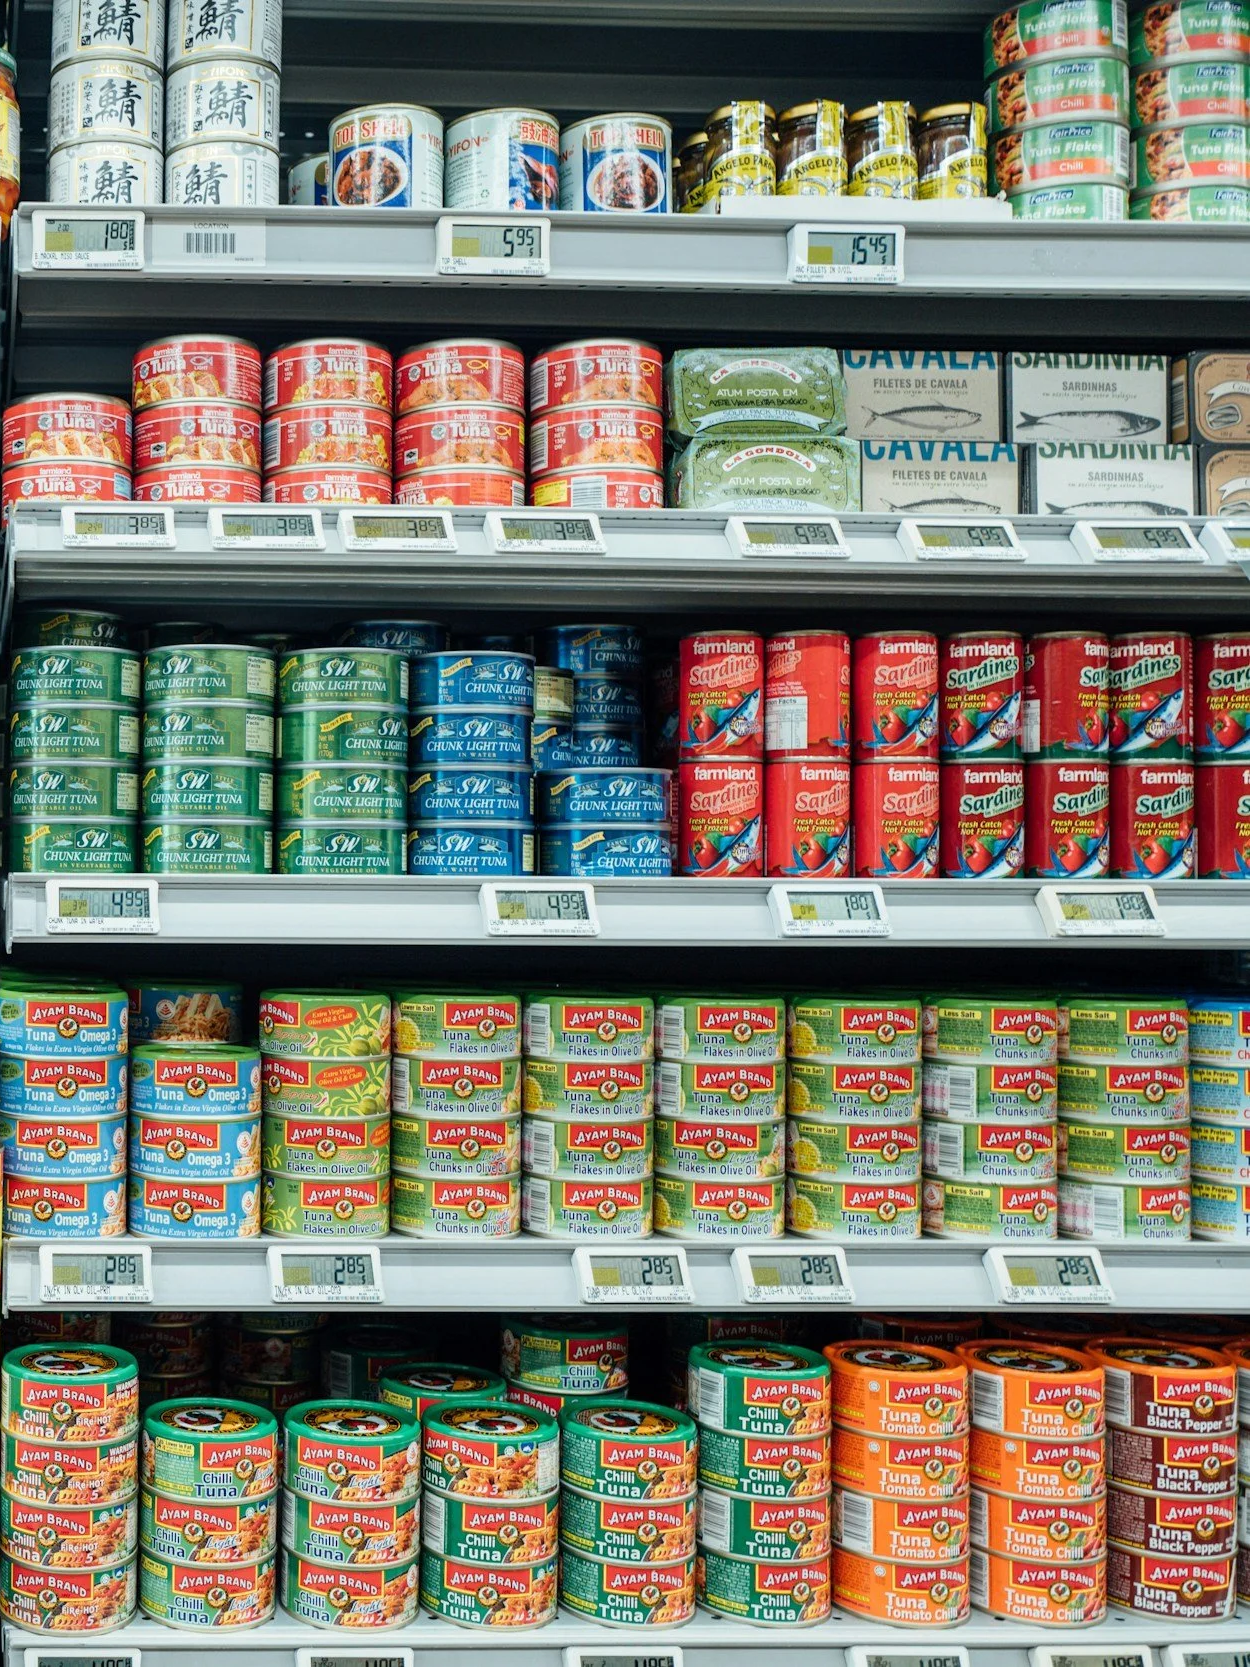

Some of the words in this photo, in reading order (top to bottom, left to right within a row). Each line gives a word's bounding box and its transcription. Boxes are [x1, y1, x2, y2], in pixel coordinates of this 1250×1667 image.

[1053, 63, 1094, 75] FairPrice
[1034, 81, 1063, 95] Tuna
[1068, 78, 1105, 89] Flakes
[95, 80, 142, 129] 鯖
[1061, 100, 1084, 109] Chilli
[336, 125, 357, 146] TOP
[449, 135, 481, 159] YIFON
[1030, 144, 1060, 157] Tuna
[1065, 140, 1102, 152] Flakes
[713, 156, 752, 180] ANGELO
[1060, 163, 1083, 171] Chilli
[421, 359, 462, 376] Tuna
[874, 378, 912, 389] FILETES
[915, 379, 927, 389] DE
[931, 378, 968, 389] CAVALA
[1062, 381, 1117, 392] SARDINHAS
[716, 387, 747, 397] ATUM
[750, 387, 779, 397] POSTA
[782, 388, 798, 397] EM
[54, 412, 95, 429] Tuna
[199, 418, 237, 434] Tuna
[745, 448, 813, 471] GONDOLA
[693, 640, 755, 655] farmland
[690, 655, 759, 684] Sardines
[947, 657, 1018, 688] Sardines
[17, 678, 42, 690] CHUNK
[45, 679, 73, 690] LIGHT
[75, 679, 103, 690] TUNA
[688, 691, 704, 699] Fresh
[705, 690, 727, 699] Catch
[426, 740, 462, 752] CHUNK
[466, 741, 496, 752] LIGHT
[498, 741, 521, 752] TUNA
[570, 799, 605, 811] CHUNK
[610, 799, 639, 811] LIGHT
[641, 800, 663, 811] TUNA
[32, 1006, 64, 1022] AYAM
[69, 1004, 103, 1023] BRAND
[1076, 1011, 1091, 1019] Less
[1093, 1011, 1110, 1019] Salt
[26, 1029, 55, 1041] Tuna
[80, 1030, 110, 1044] Omega
[110, 1029, 116, 1041] 3
[1125, 1036, 1155, 1047] Tuna
[1115, 1069, 1151, 1086] AYAM
[1155, 1068, 1183, 1087] BRAND
[287, 1149, 314, 1161] Tuna
[672, 1148, 697, 1160] Tuna
[678, 1162, 707, 1175] Flakes
[720, 1165, 744, 1175] Olive
[746, 1166, 757, 1175] Oil
[26, 1389, 57, 1402] AYAM
[61, 1389, 101, 1408] BRAND
[747, 1407, 778, 1420] Chilli
[879, 1408, 921, 1423] Tuna
[1146, 1402, 1191, 1420] Tuna
[739, 1417, 784, 1434] Tuna
[879, 1422, 927, 1435] Tomato
[929, 1422, 953, 1435] Chilli
[1147, 1417, 1183, 1430] Black
[1185, 1418, 1223, 1432] Pepper
[458, 1544, 501, 1562] Tuna
